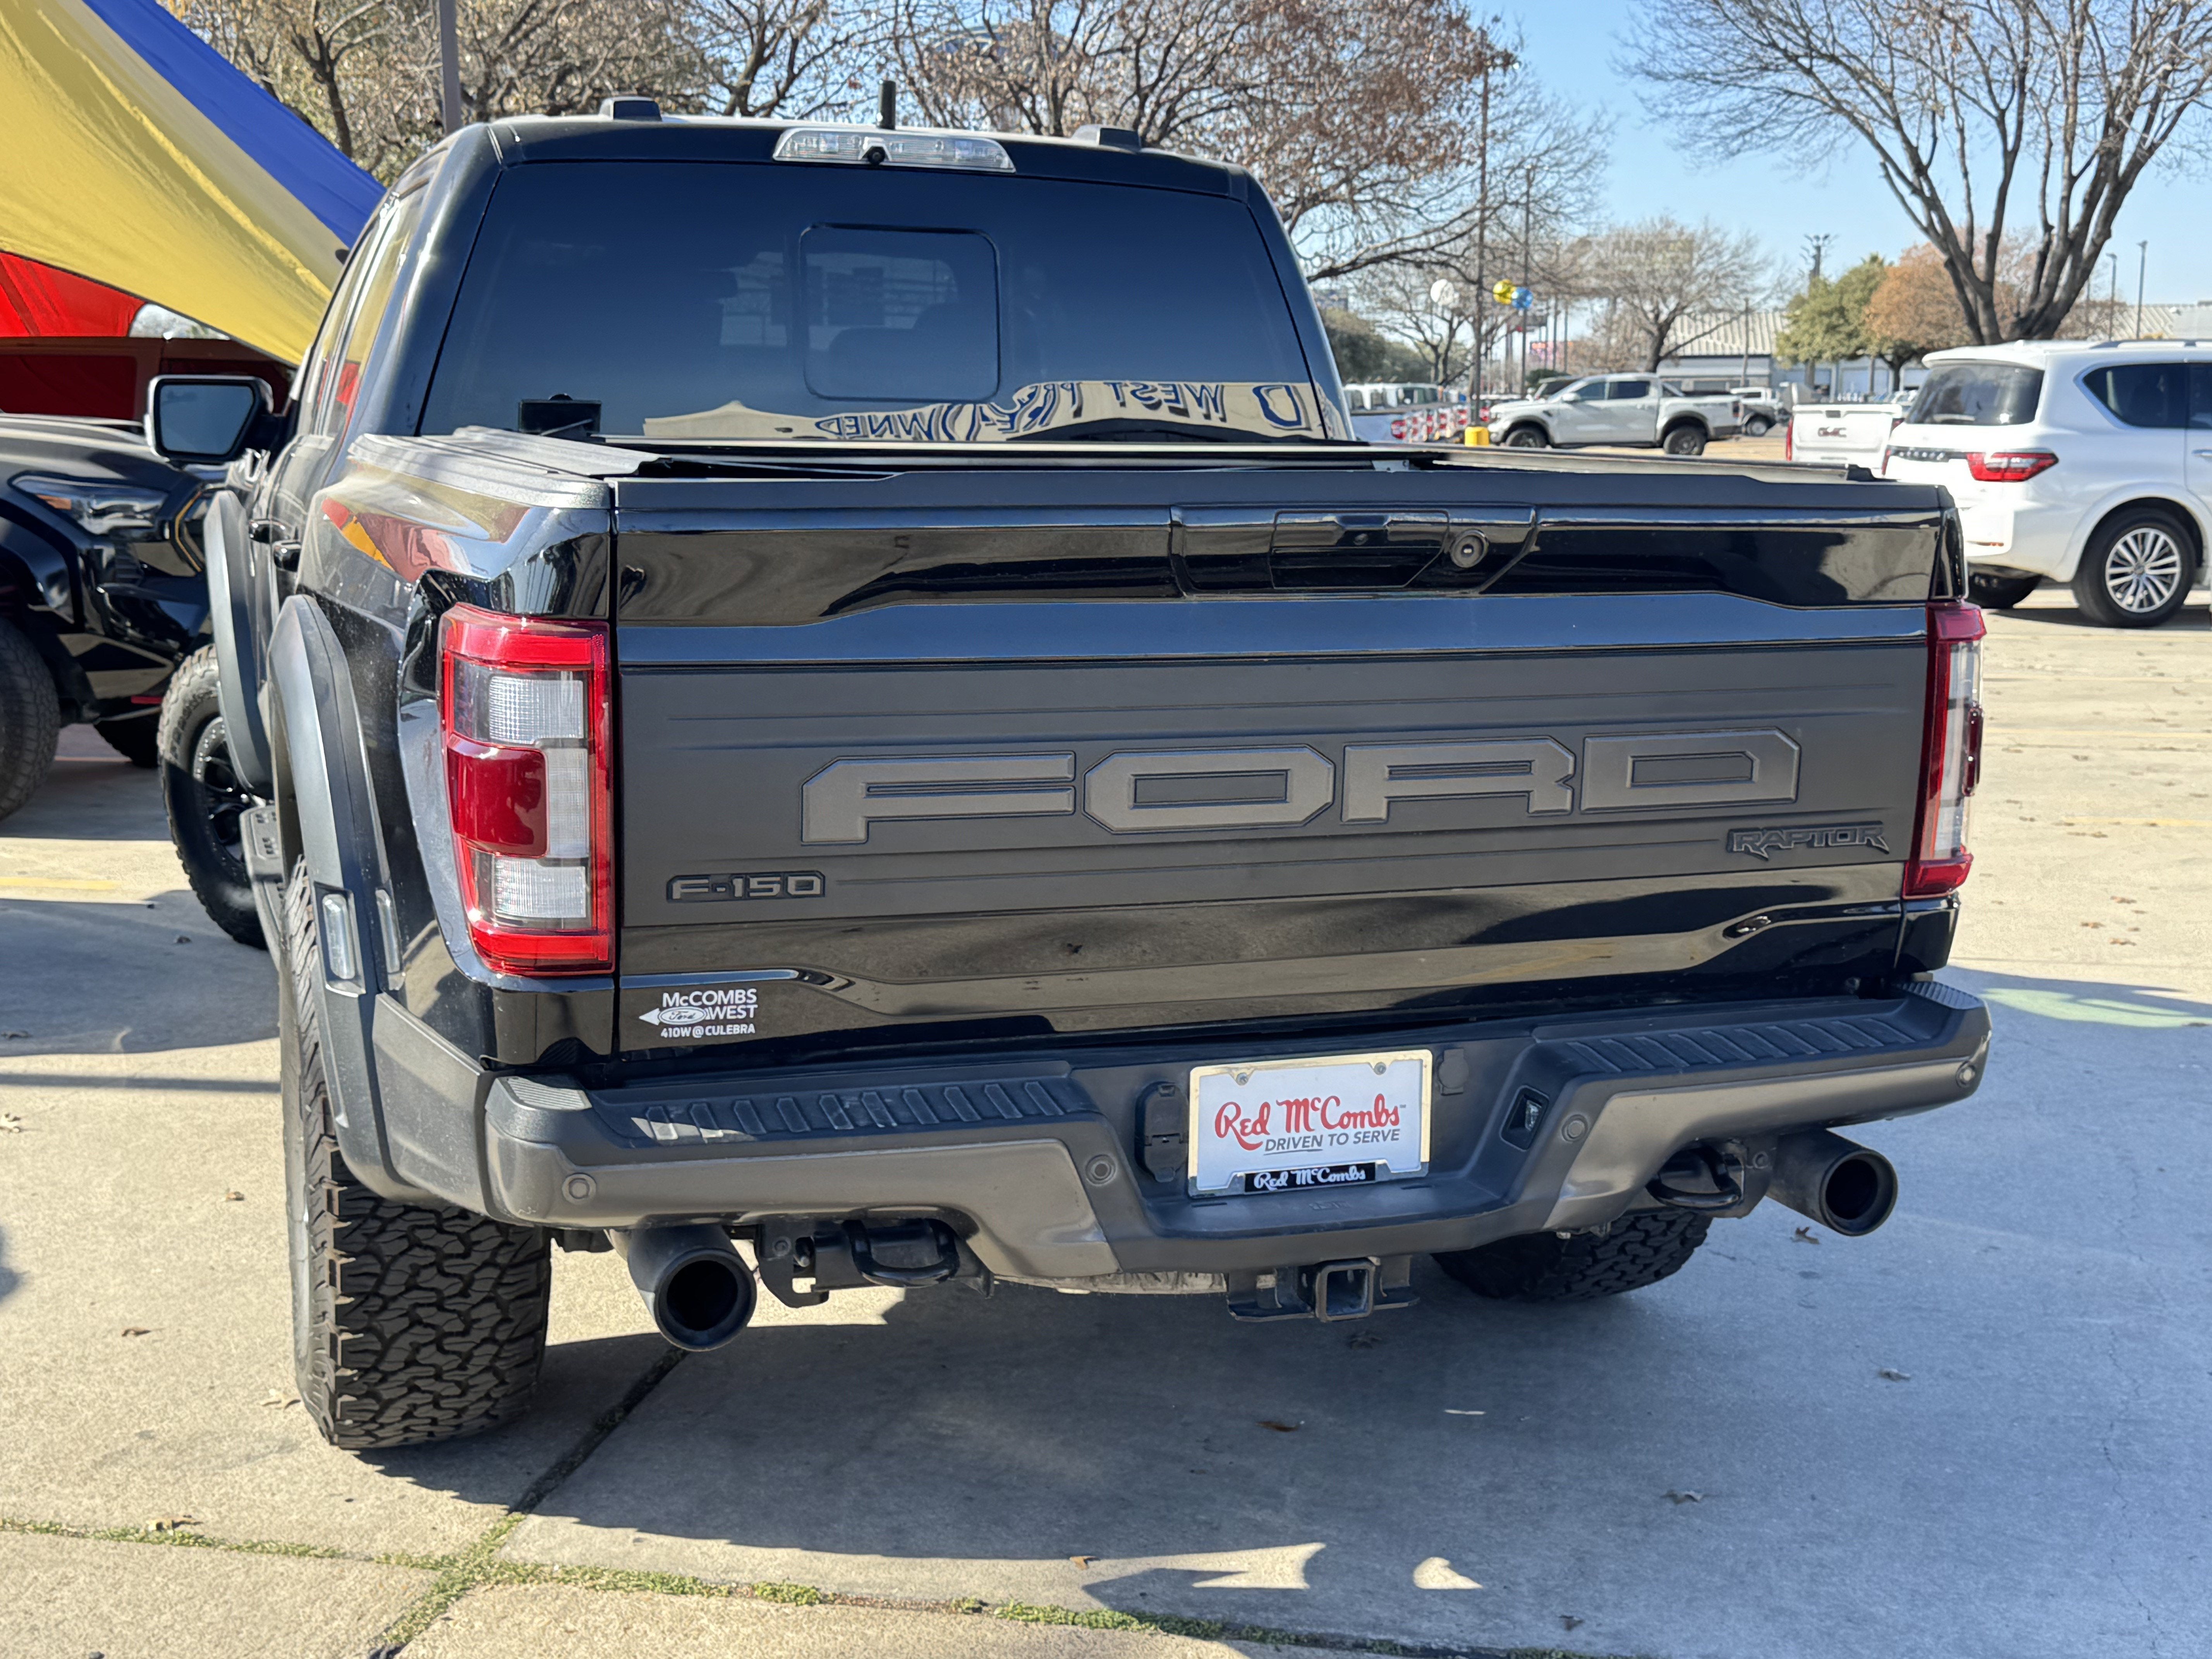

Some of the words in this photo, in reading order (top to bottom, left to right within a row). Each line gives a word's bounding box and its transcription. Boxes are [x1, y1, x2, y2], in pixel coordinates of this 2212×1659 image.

[1818, 426, 1847, 437] GMC
[802, 730, 1801, 843] FORD
[1728, 821, 1890, 860] RAPTOR
[668, 873, 824, 902] F-150
[663, 989, 757, 1007] McCOMBS
[708, 1005, 758, 1020] WEST
[1214, 1101, 1271, 1151] Red
[1276, 1093, 1400, 1133] McCombs
[1264, 1135, 1323, 1152] DRIVEN
[1328, 1133, 1349, 1146] TO
[1353, 1129, 1400, 1144] SERVE
[1254, 1170, 1288, 1190] Red
